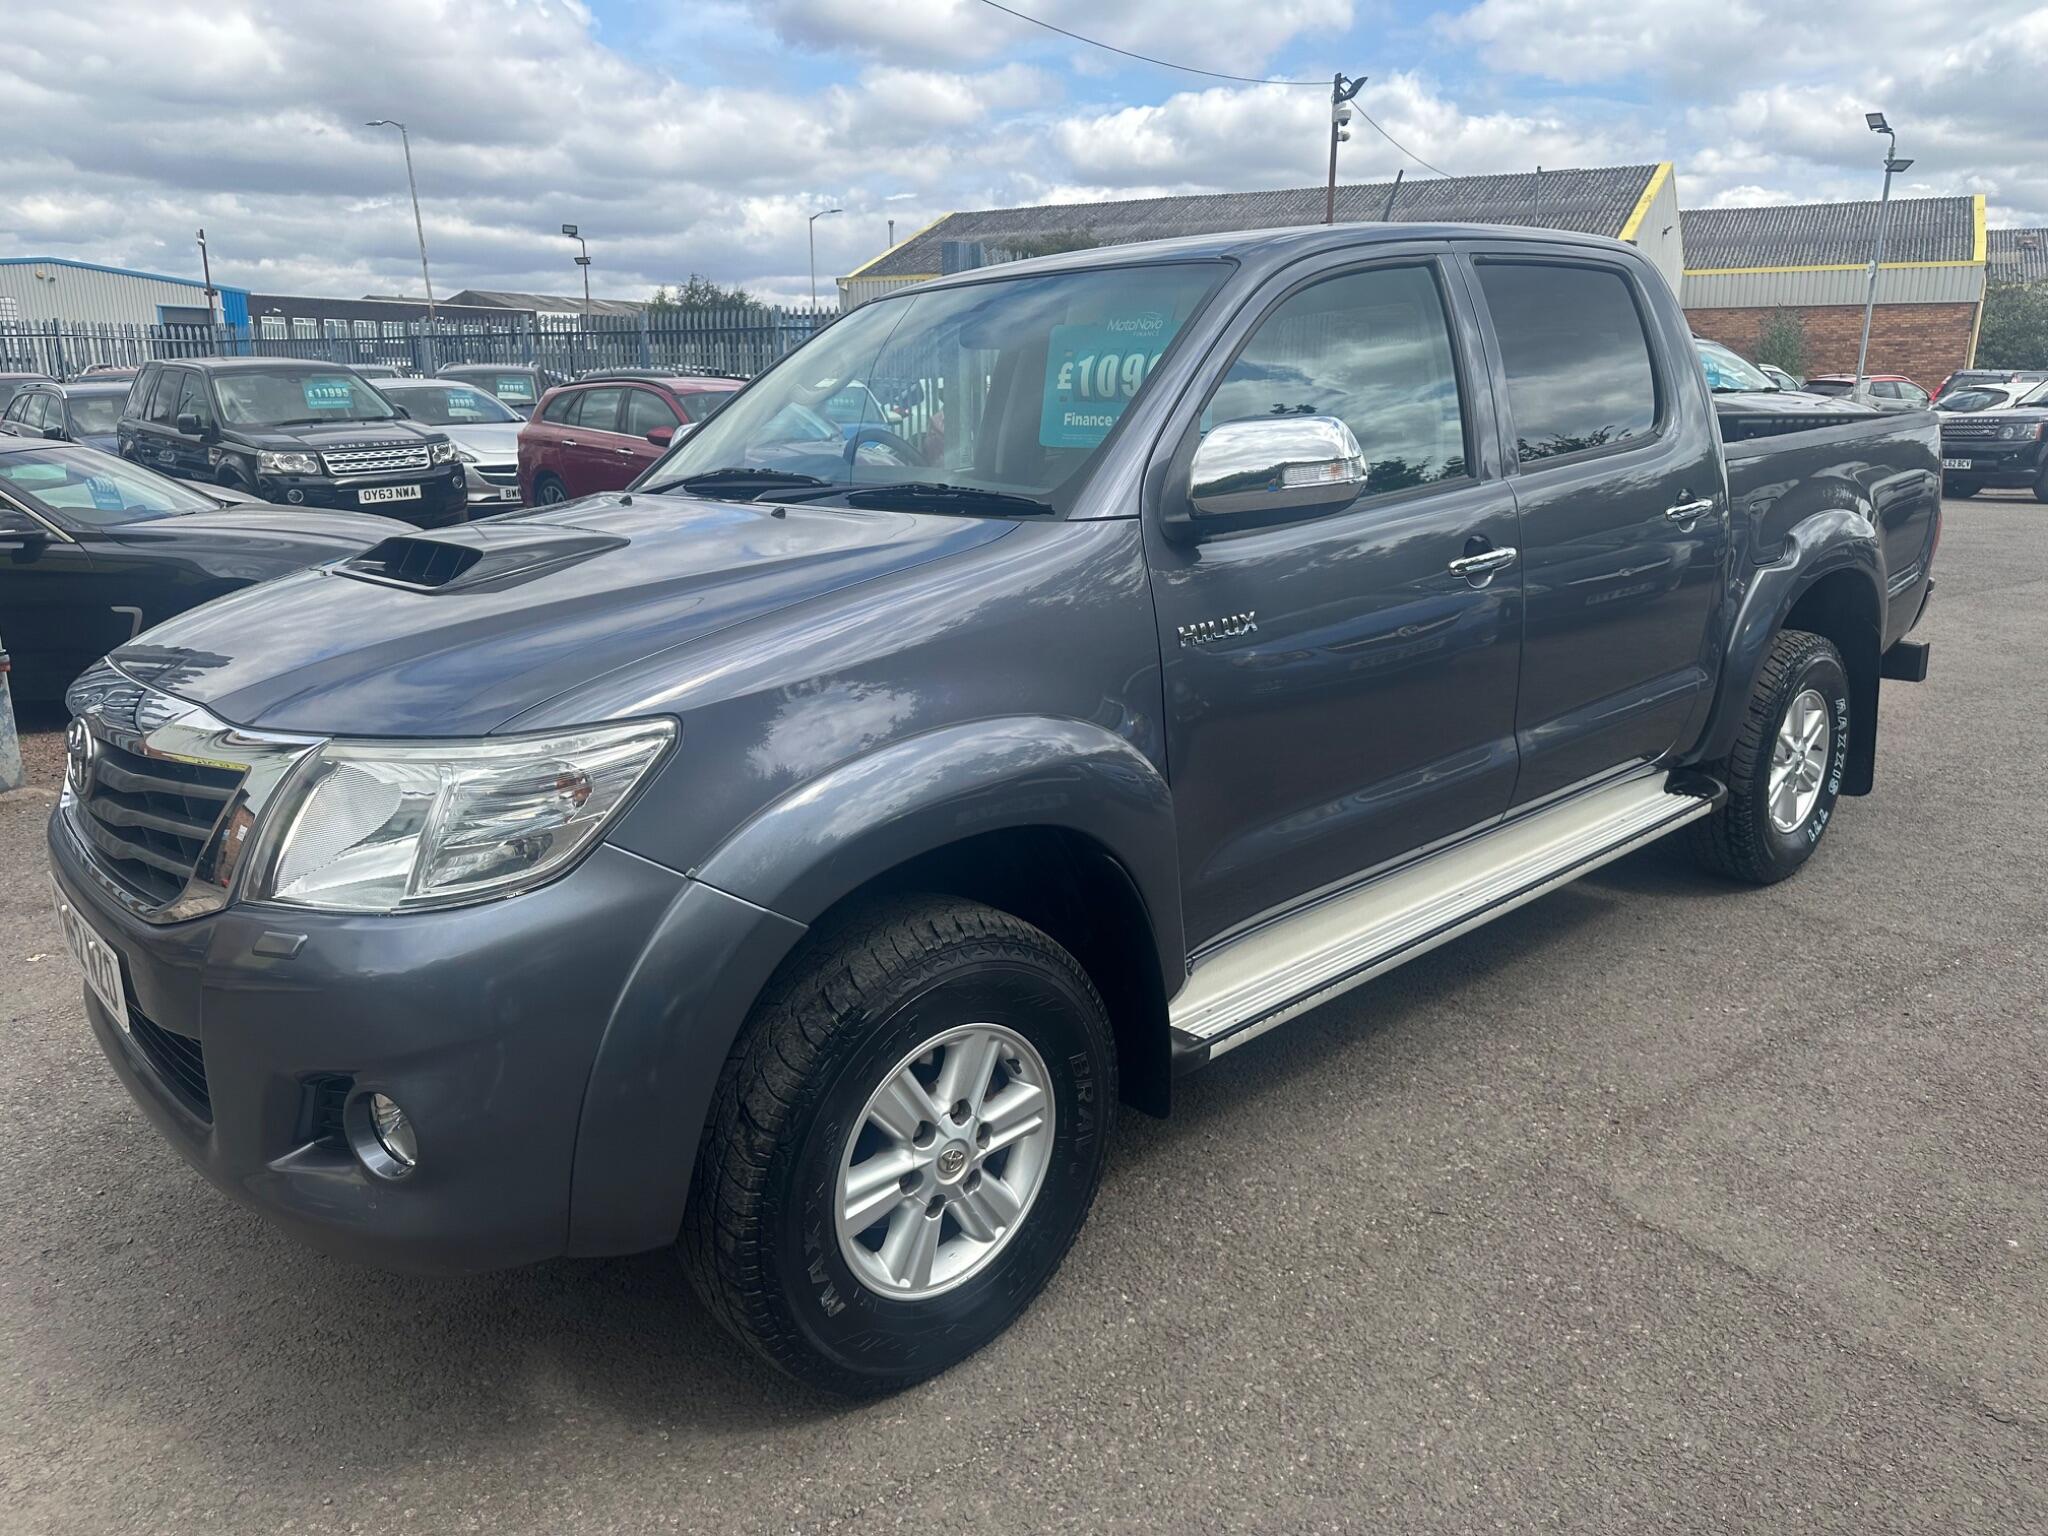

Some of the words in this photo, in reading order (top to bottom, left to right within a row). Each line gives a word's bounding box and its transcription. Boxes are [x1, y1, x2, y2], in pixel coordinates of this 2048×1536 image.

[1064, 413, 1112, 427] Finance
[363, 489, 393, 501] OY63
[396, 487, 417, 499] NWA
[1177, 611, 1258, 647] HILUX
[1828, 698, 1848, 795] MAXXIS
